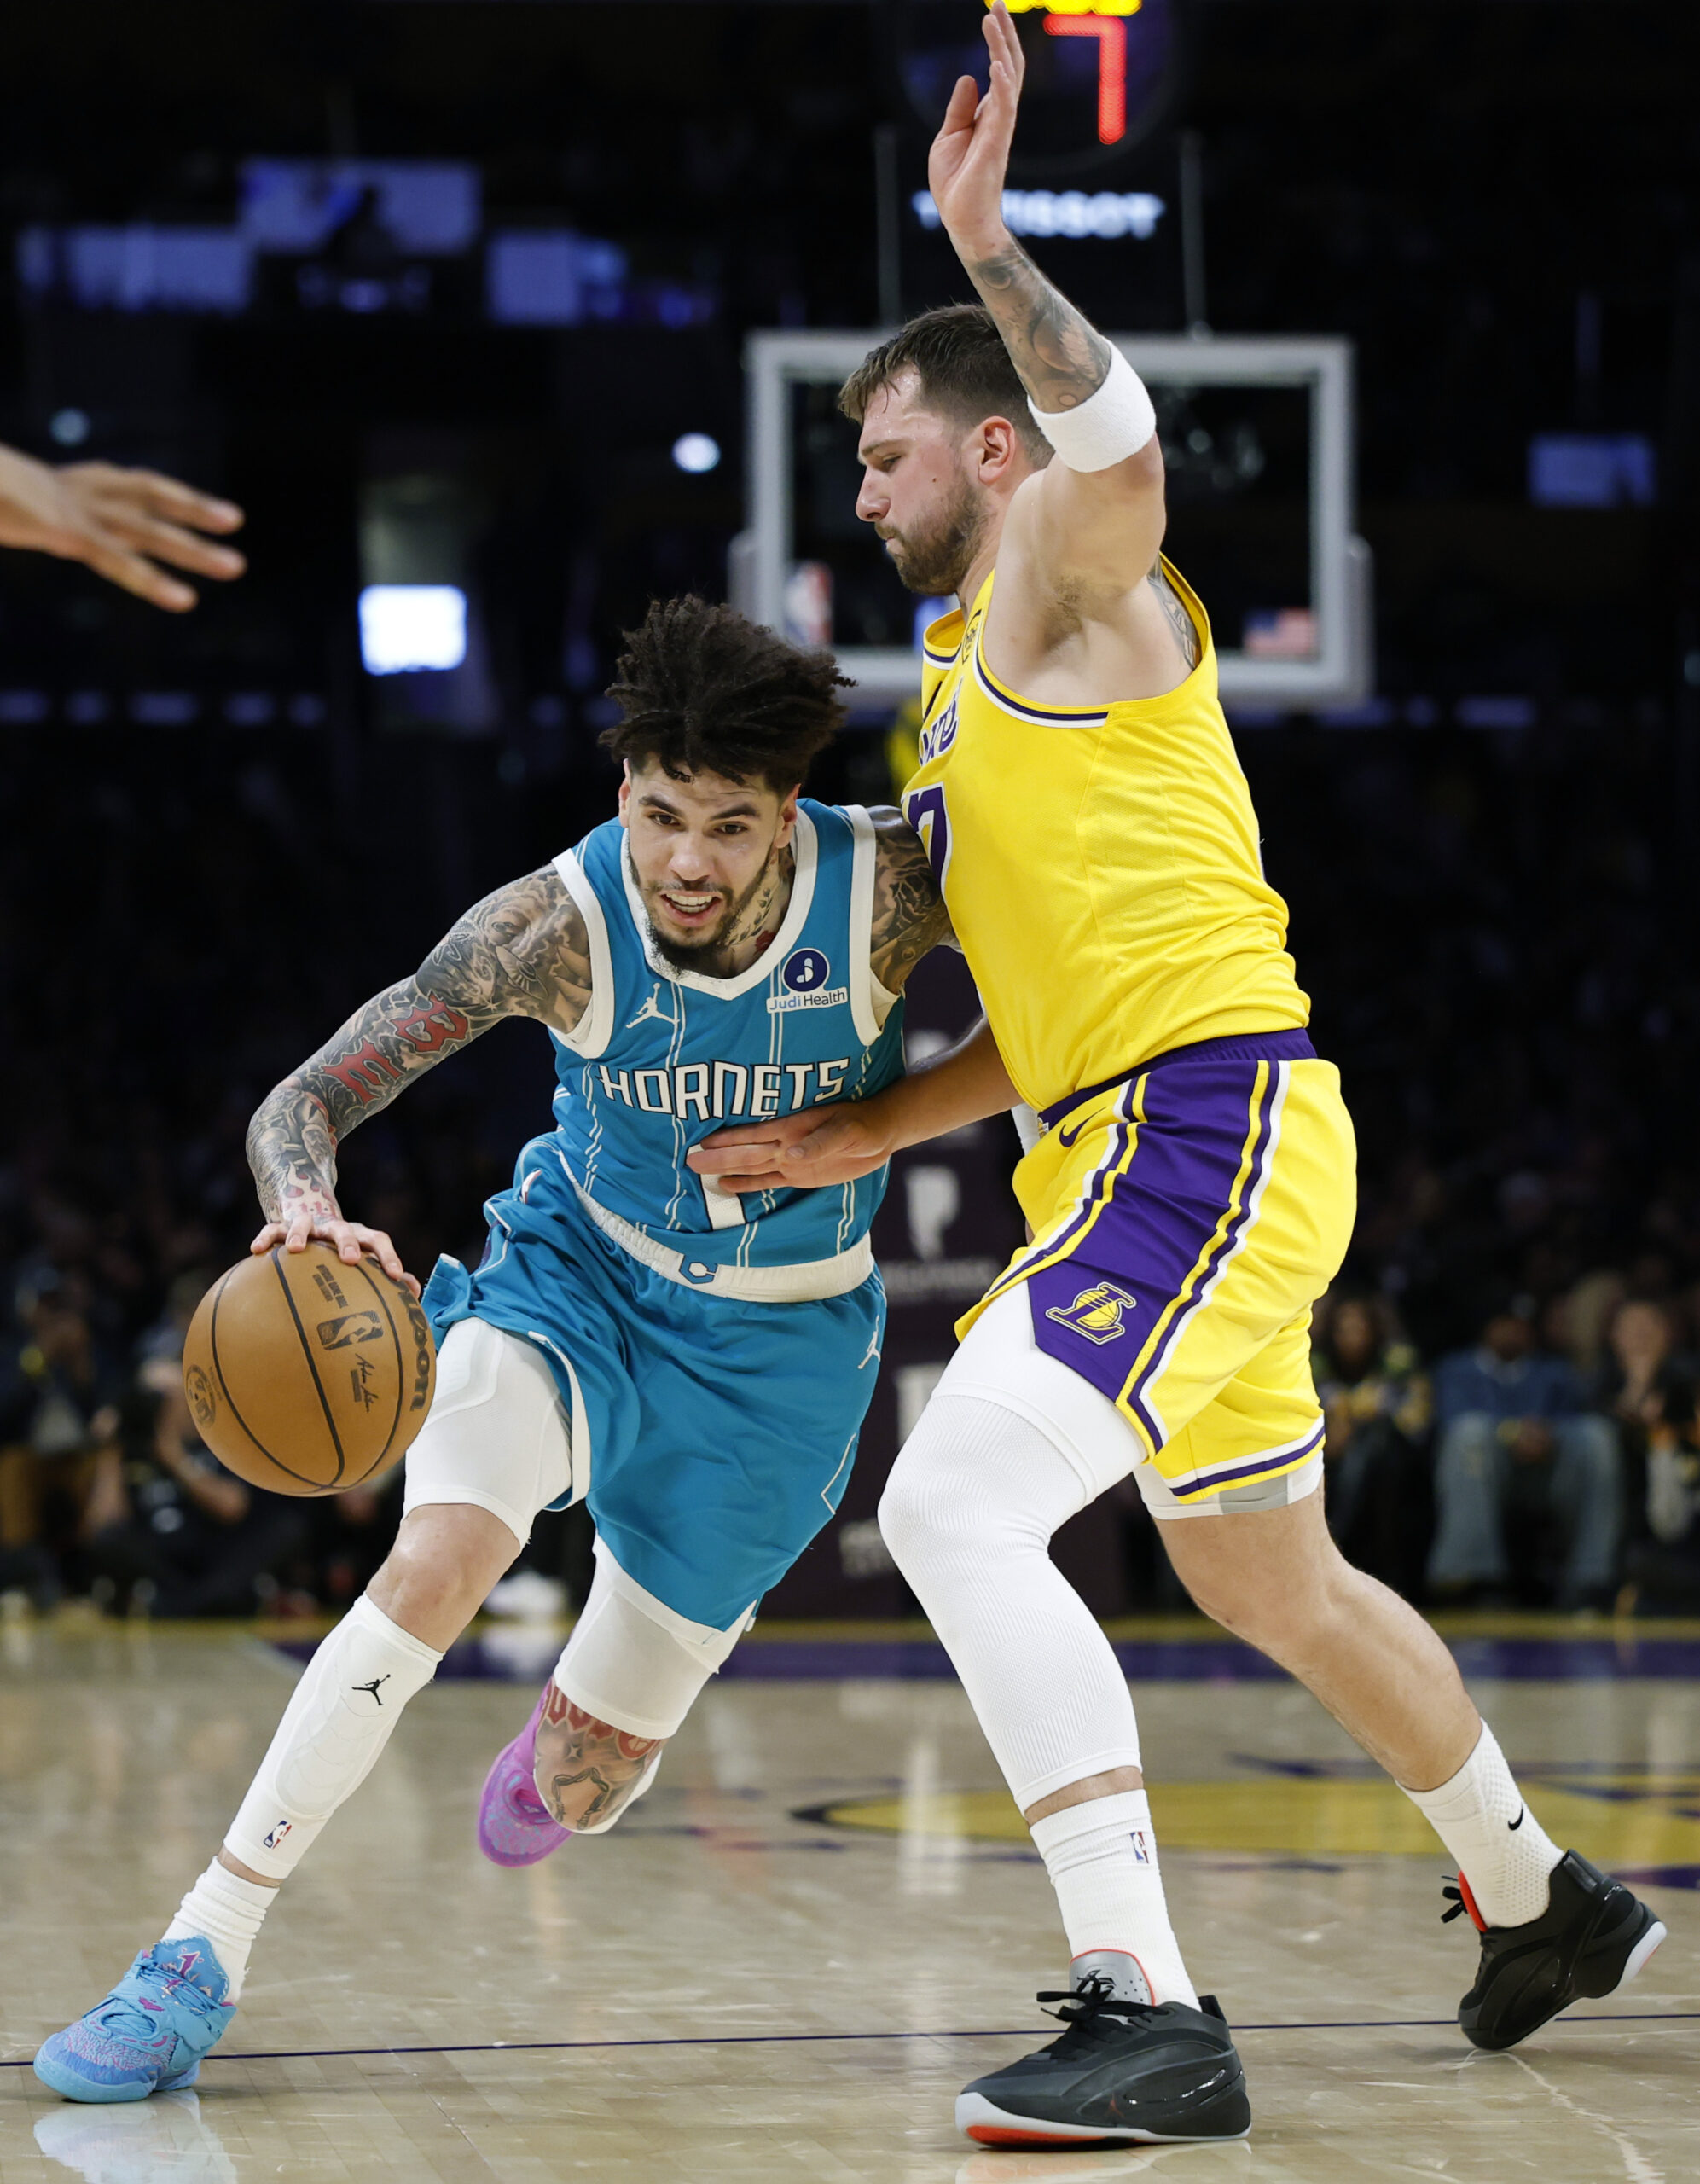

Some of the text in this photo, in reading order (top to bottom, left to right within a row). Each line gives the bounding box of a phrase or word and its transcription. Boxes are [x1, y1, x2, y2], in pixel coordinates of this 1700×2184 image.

[1001, 189, 1165, 240] ISSOT
[769, 990, 845, 1011] Judi Health
[597, 1058, 850, 1123] HORNETS
